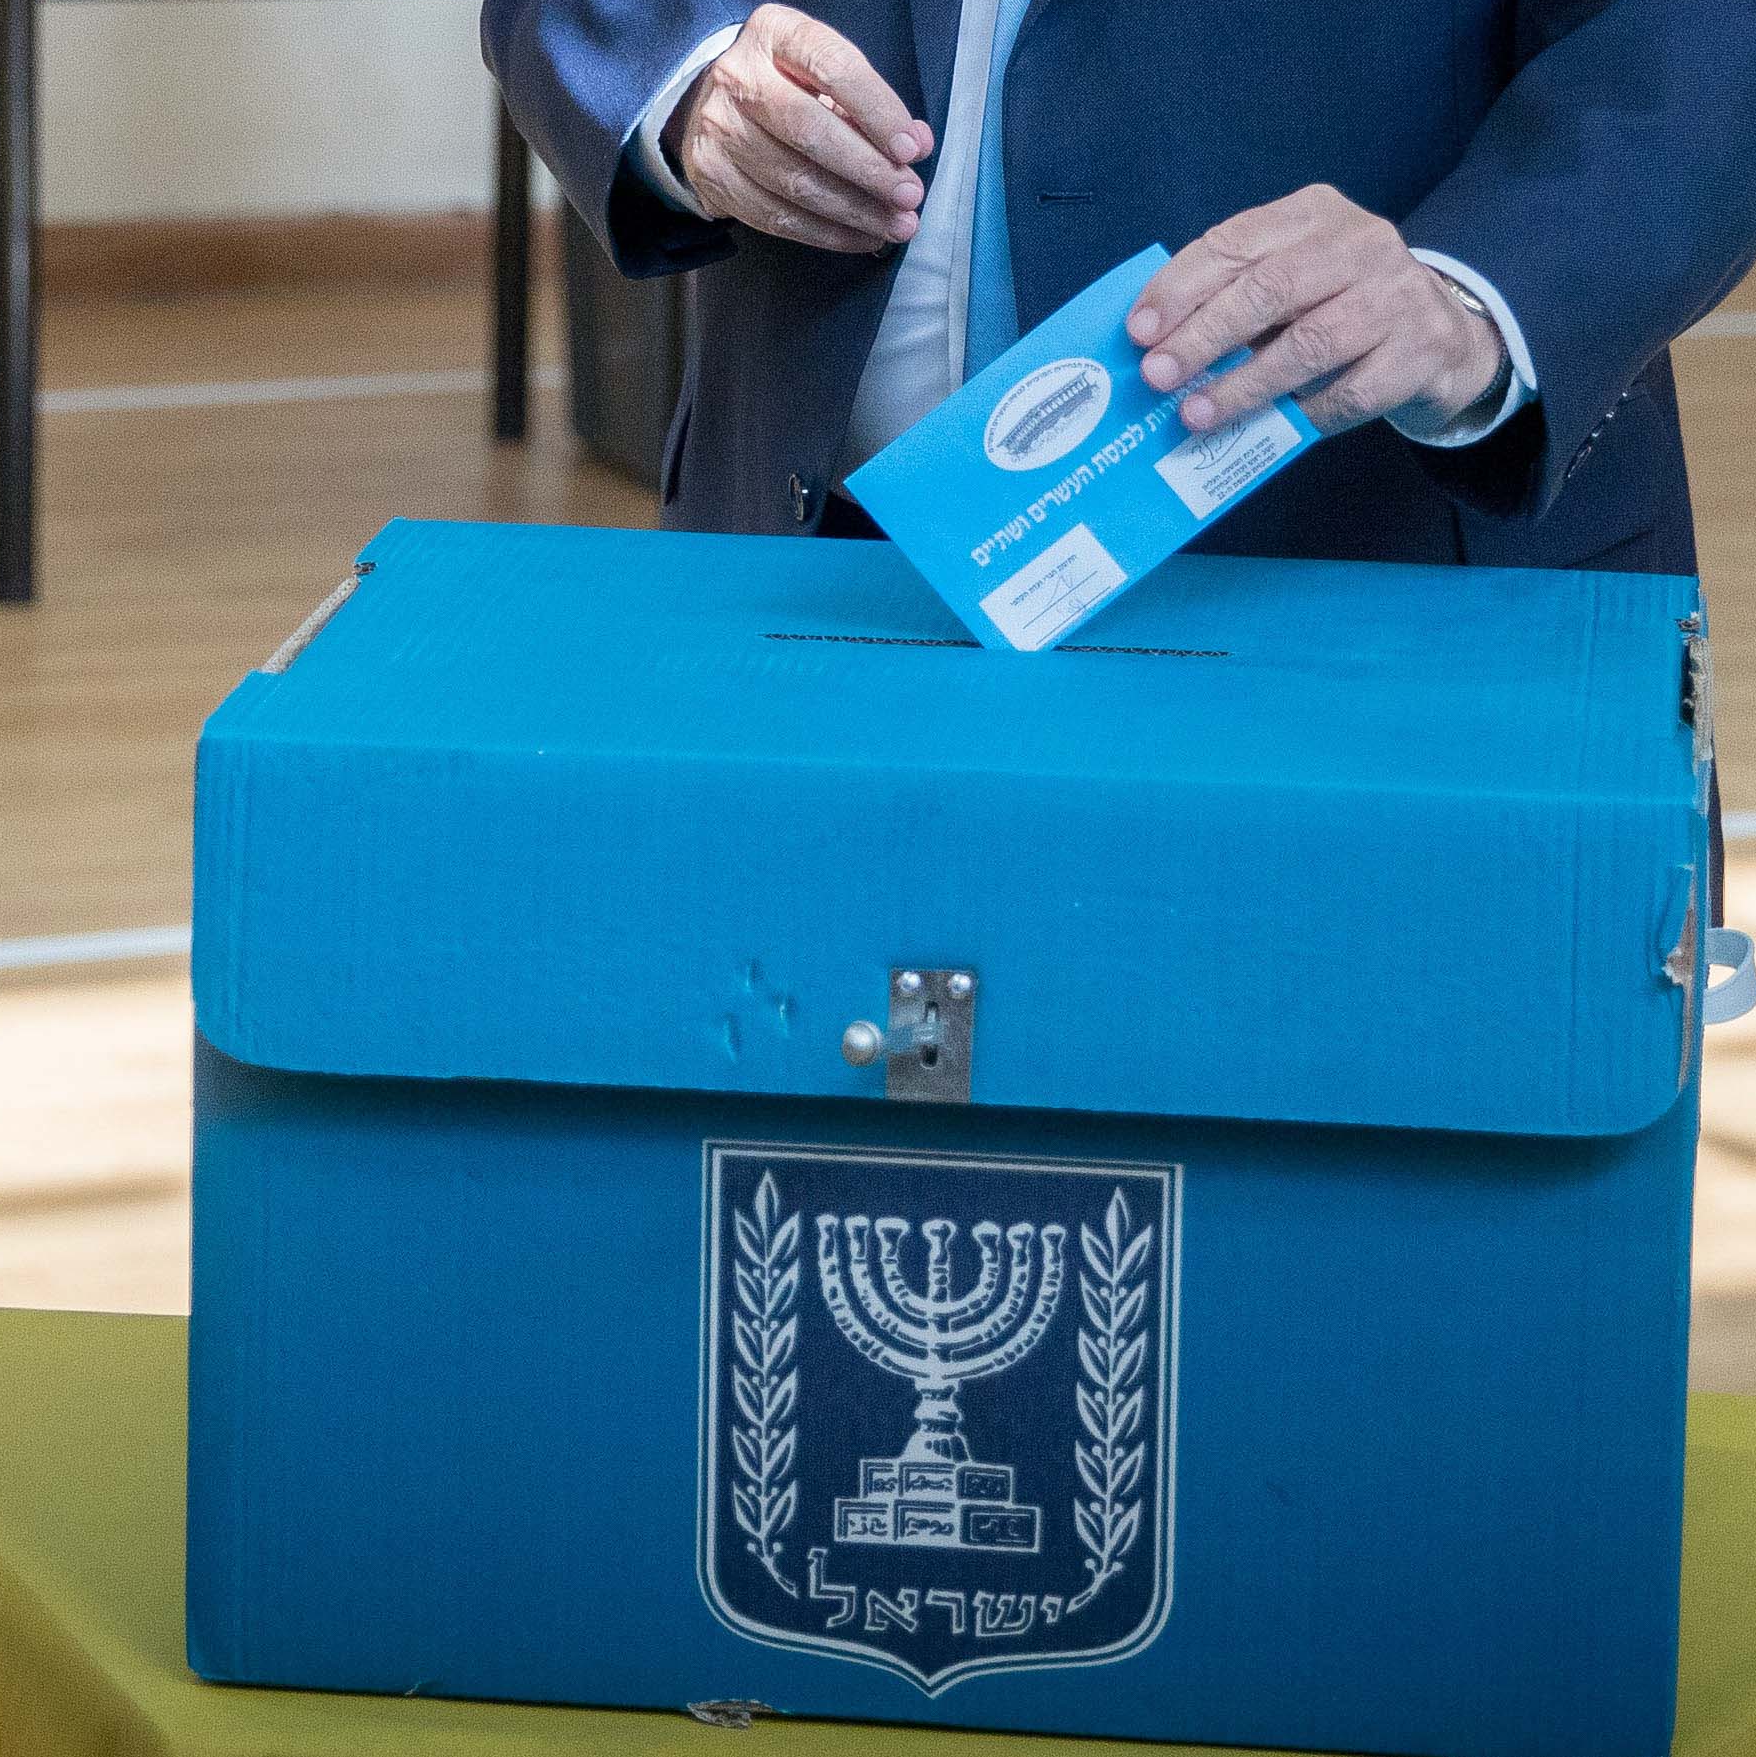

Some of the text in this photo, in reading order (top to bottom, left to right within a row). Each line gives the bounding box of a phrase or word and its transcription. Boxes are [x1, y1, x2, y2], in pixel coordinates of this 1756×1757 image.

[1091, 423, 1145, 474] לכנסת
[1027, 465, 1094, 523] העשרים
[970, 515, 1031, 567] ושתיים
[807, 1547, 1063, 1637] ישראל
